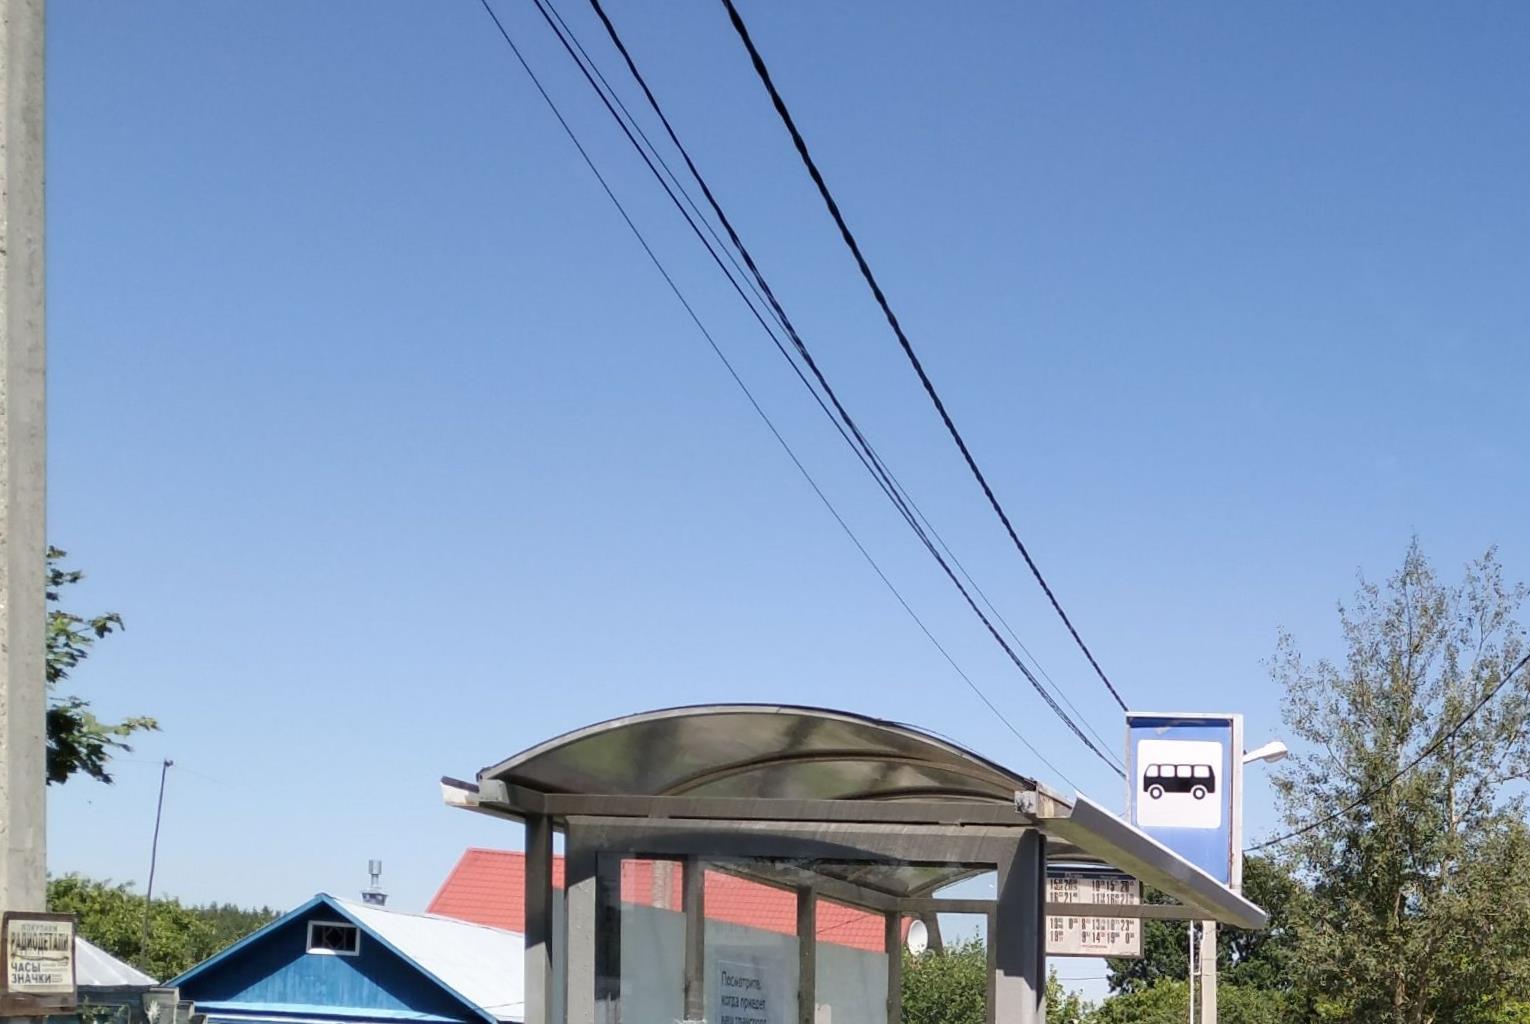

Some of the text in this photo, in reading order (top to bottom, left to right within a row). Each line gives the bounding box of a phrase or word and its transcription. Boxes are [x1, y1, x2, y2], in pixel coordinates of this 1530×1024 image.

[11, 931, 69, 953] РАДИОДЕТАЛИ
[11, 962, 41, 973] ЧАСЫ
[11, 973, 52, 984] ЗНАЧКИ
[721, 995, 739, 1009] когда
